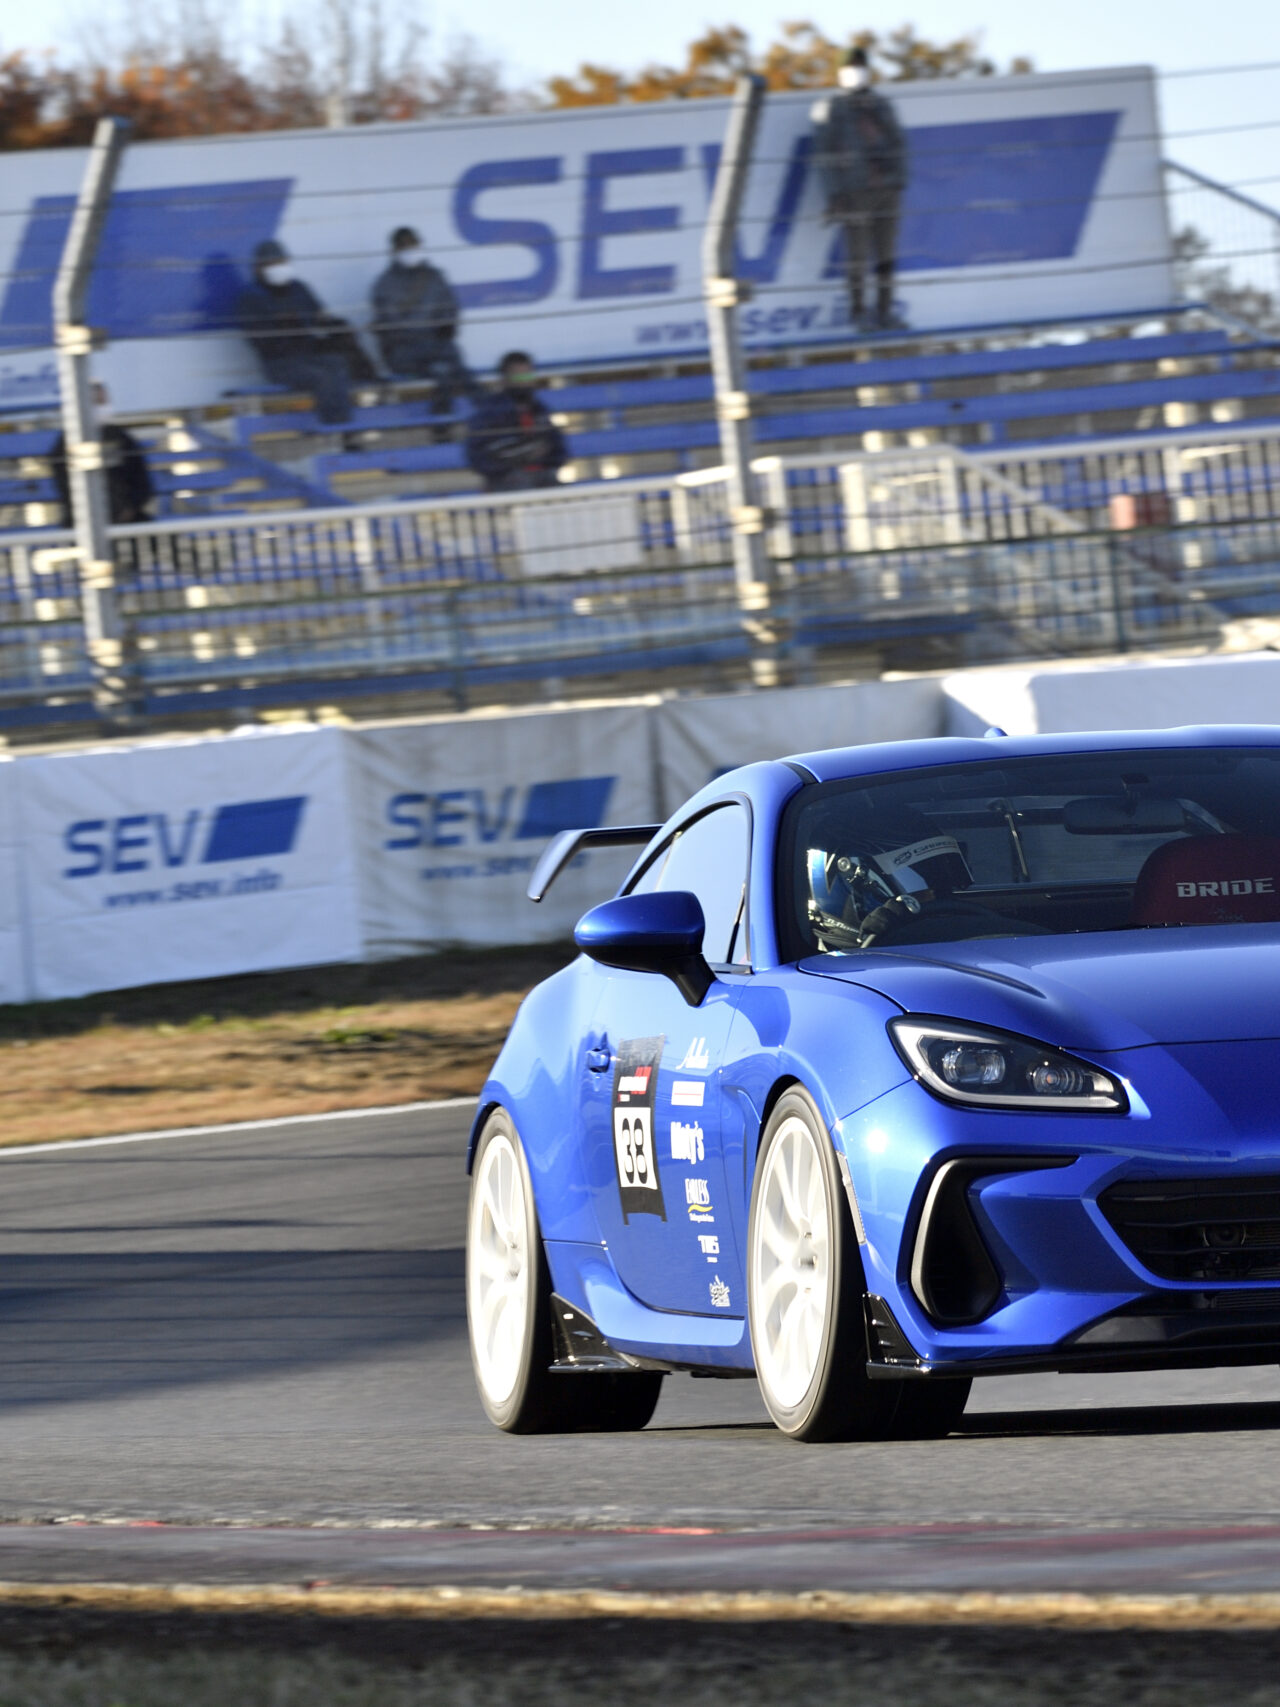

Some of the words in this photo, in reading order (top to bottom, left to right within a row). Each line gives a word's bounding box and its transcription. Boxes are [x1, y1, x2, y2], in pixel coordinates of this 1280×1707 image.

[453, 137, 815, 309] SEV
[63, 809, 202, 879] SEV
[384, 785, 519, 850] SEV
[1176, 877, 1276, 898] BRIDE
[622, 1117, 648, 1184] 38
